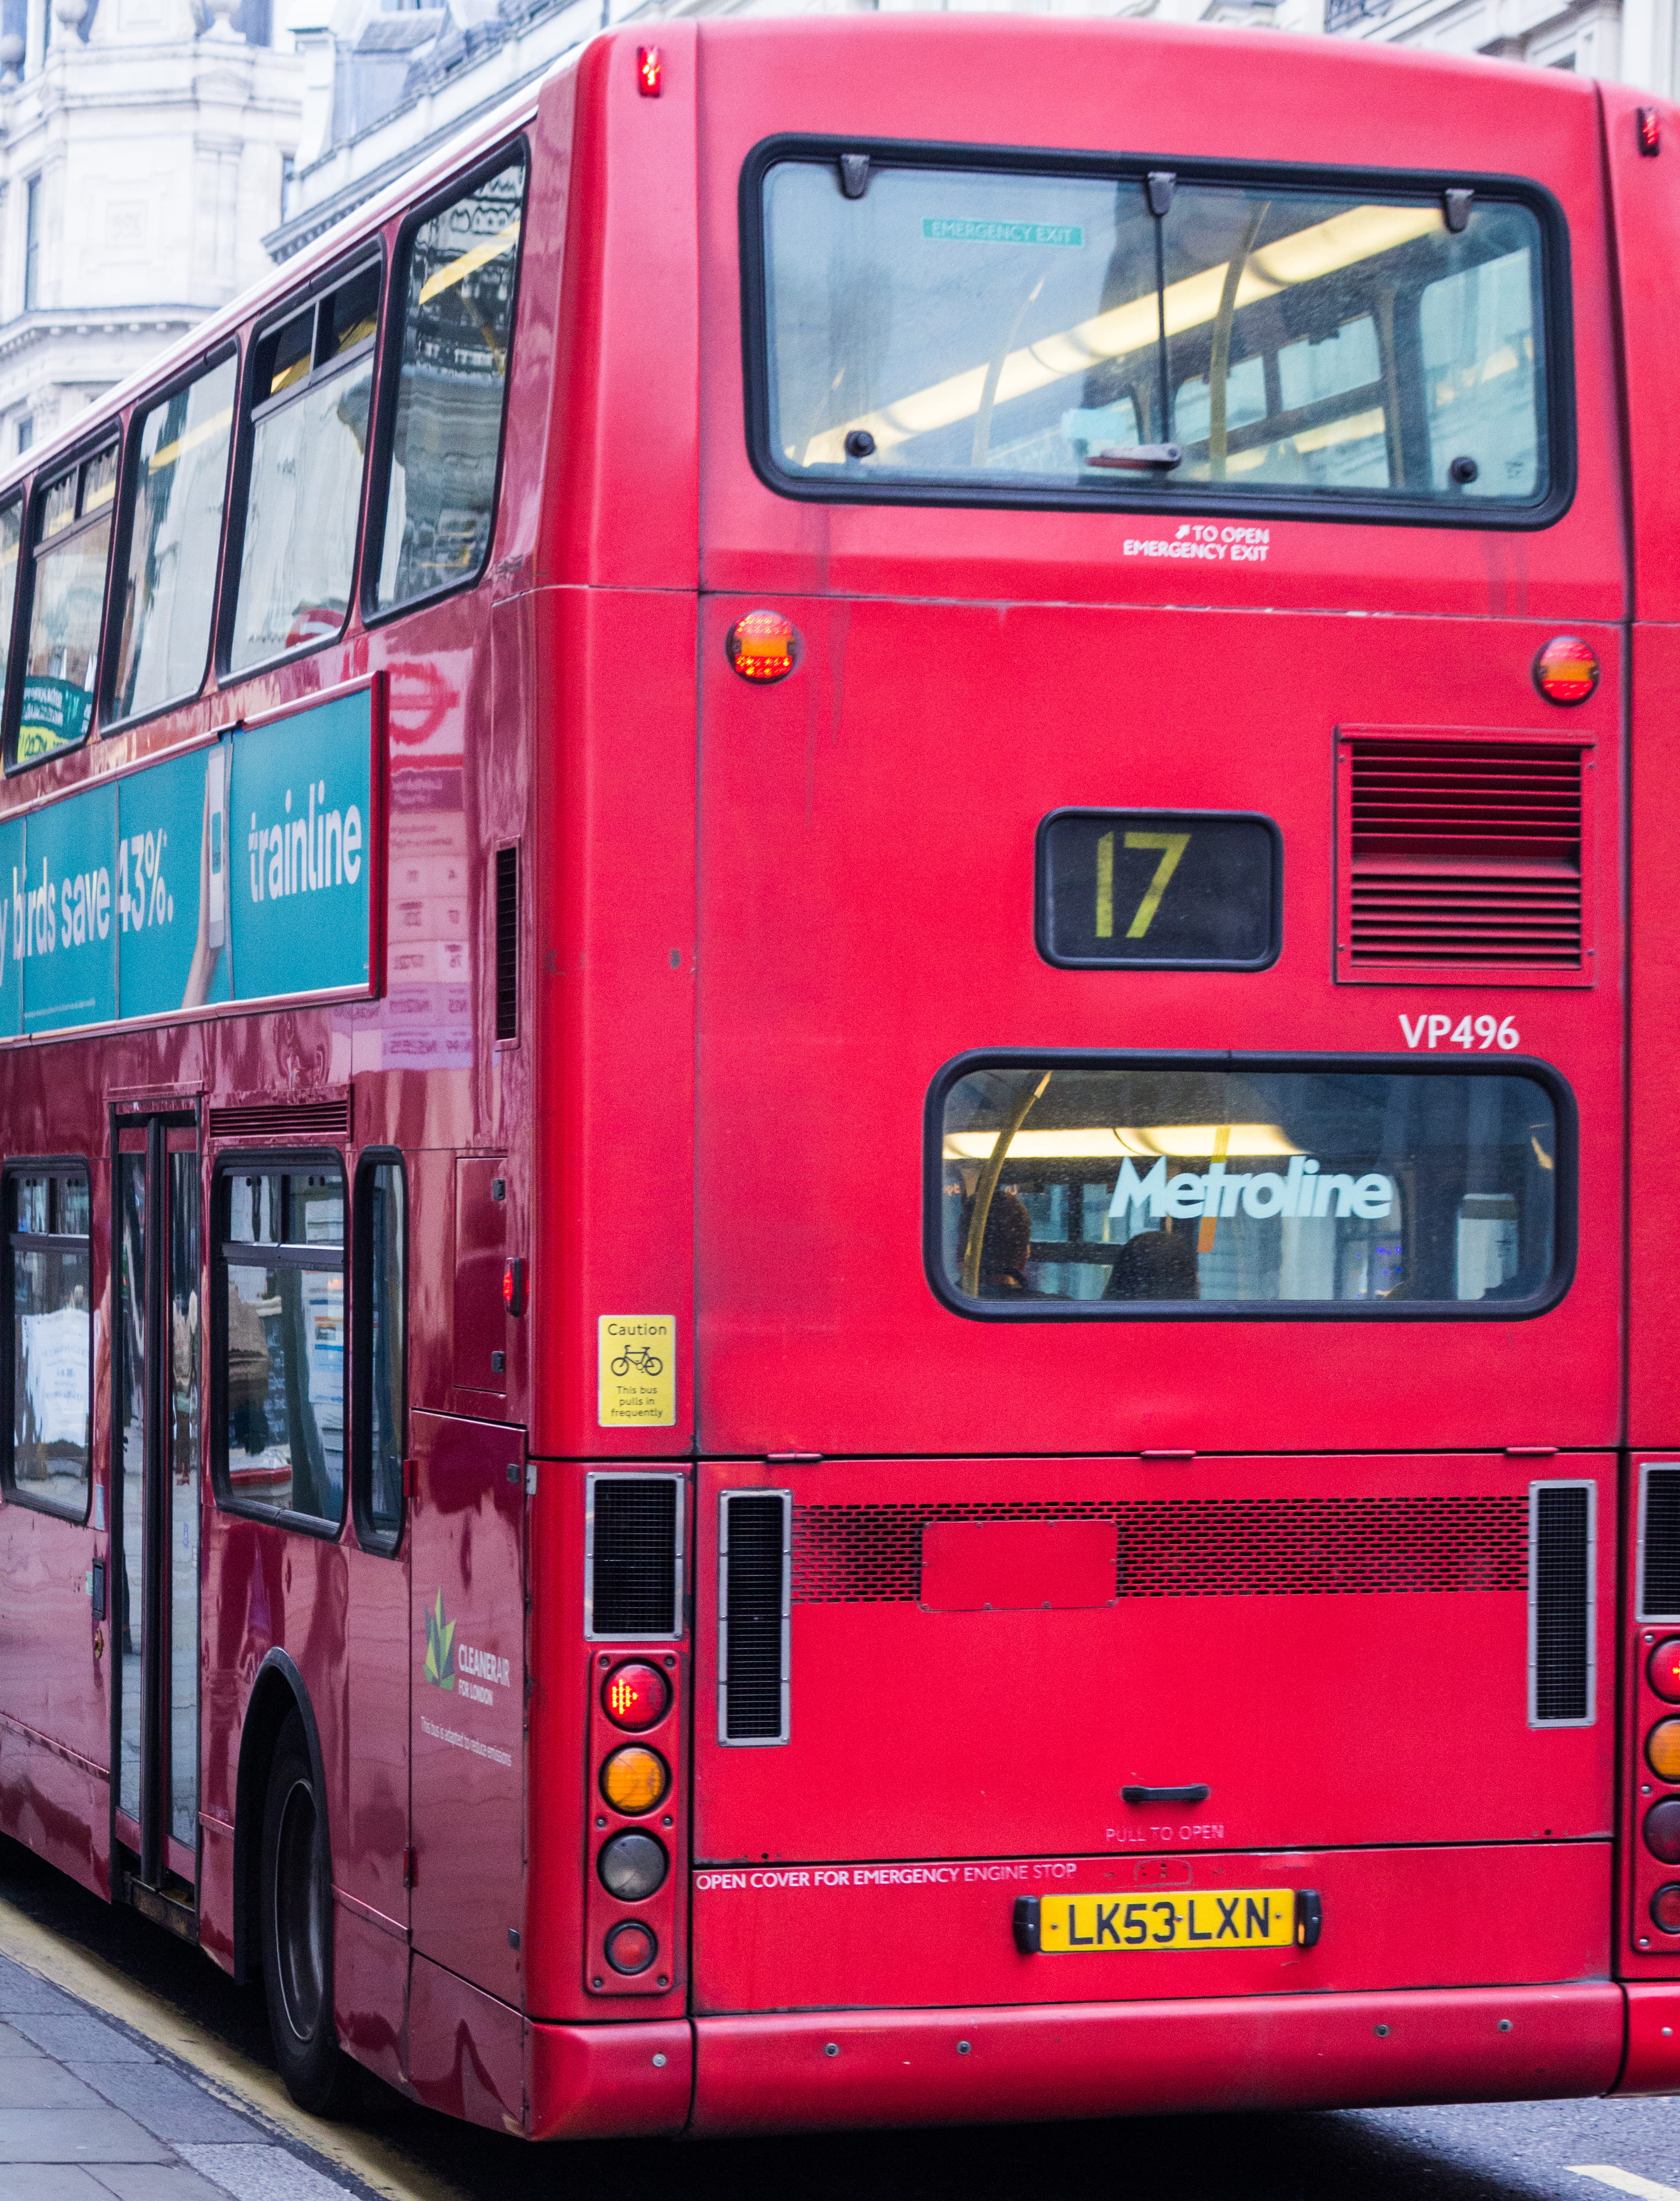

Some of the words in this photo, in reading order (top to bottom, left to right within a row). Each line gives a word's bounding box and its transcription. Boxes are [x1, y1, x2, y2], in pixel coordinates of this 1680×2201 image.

[931, 221, 1032, 241] EMERGENCY
[1036, 226, 1071, 244] EXIT
[1191, 525, 1218, 542] TO
[1221, 527, 1270, 544] OPEN
[1123, 539, 1228, 560] EMERGENCY
[1230, 545, 1270, 561] EXIT
[248, 779, 362, 903] trainline
[1096, 831, 1192, 938] 17
[13, 856, 56, 960] birds
[61, 866, 110, 949] save
[1398, 1014, 1521, 1050] VP496
[1108, 1155, 1394, 1219] Metroline
[608, 1323, 667, 1336] Caution
[616, 1386, 637, 1394] This
[619, 1397, 644, 1406] pulls
[646, 1397, 655, 1405] in
[611, 1409, 663, 1418] frequently
[458, 1643, 498, 1684] CLEANER
[1105, 1828, 1146, 1842] PULL
[1149, 1826, 1173, 1841] TO
[1179, 1825, 1225, 1840] OPEN
[696, 1874, 746, 1890] OPEN
[750, 1872, 810, 1888] COVER
[814, 1870, 850, 1886] FOR
[853, 1867, 960, 1885] EMERGENCY
[963, 1865, 1030, 1882] ENGINE
[1032, 1863, 1077, 1879] STOP
[1068, 1902, 1175, 1945] LK53
[1188, 1897, 1269, 1940] LXN
